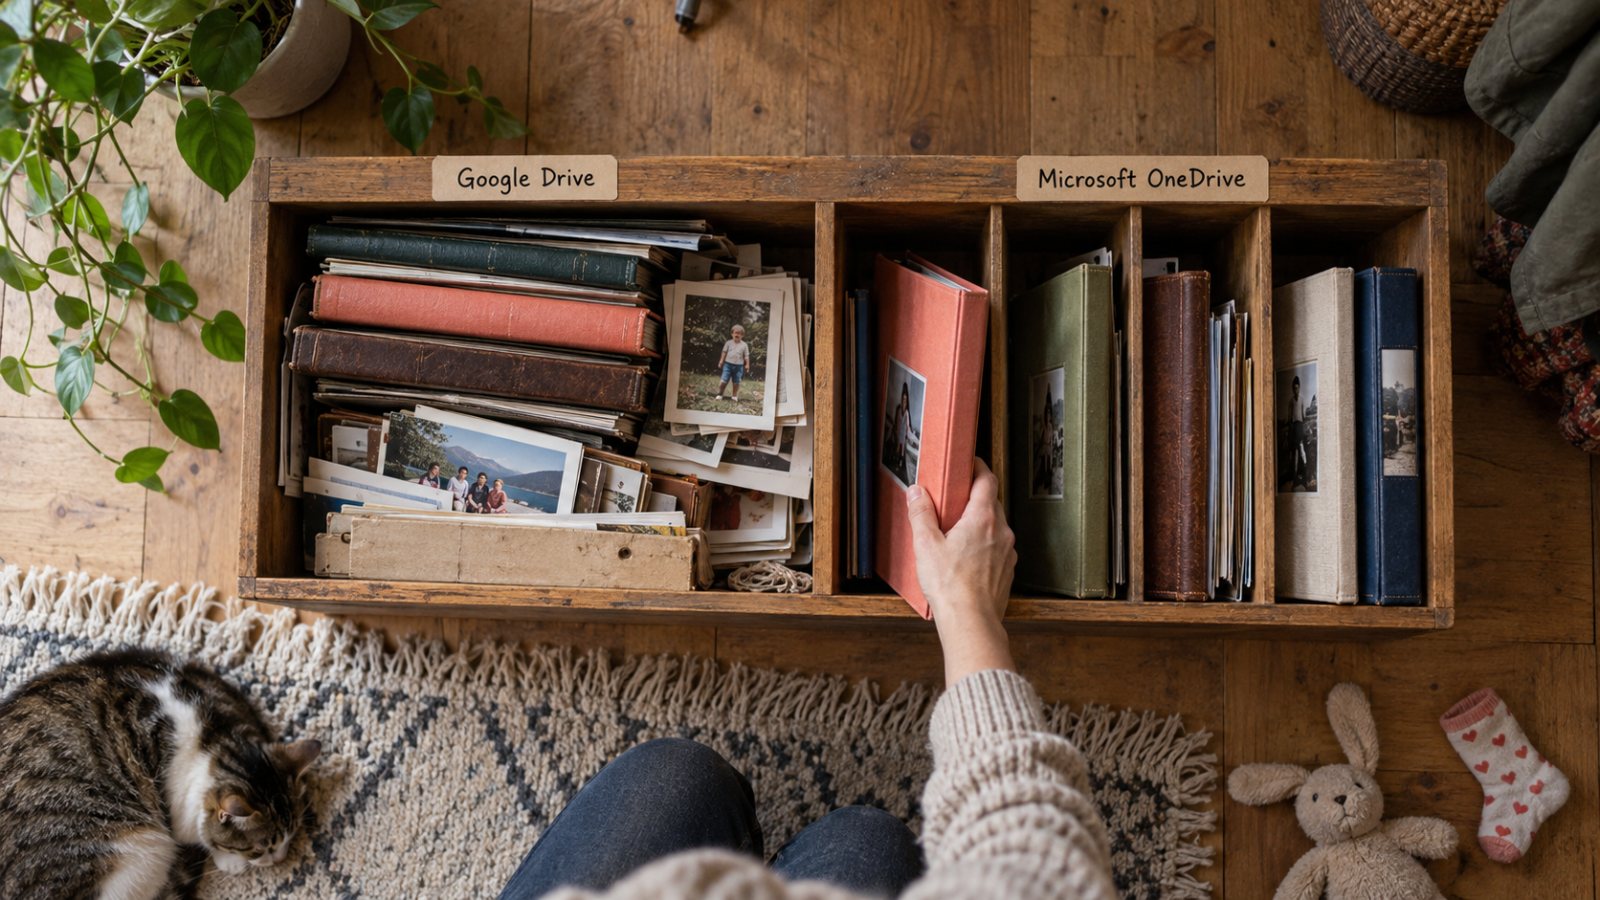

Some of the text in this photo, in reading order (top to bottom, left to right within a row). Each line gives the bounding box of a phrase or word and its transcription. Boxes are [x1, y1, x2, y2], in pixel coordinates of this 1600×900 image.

[457, 166, 595, 195] Google Drive
[1038, 167, 1246, 189] Microsoft OneDrive
